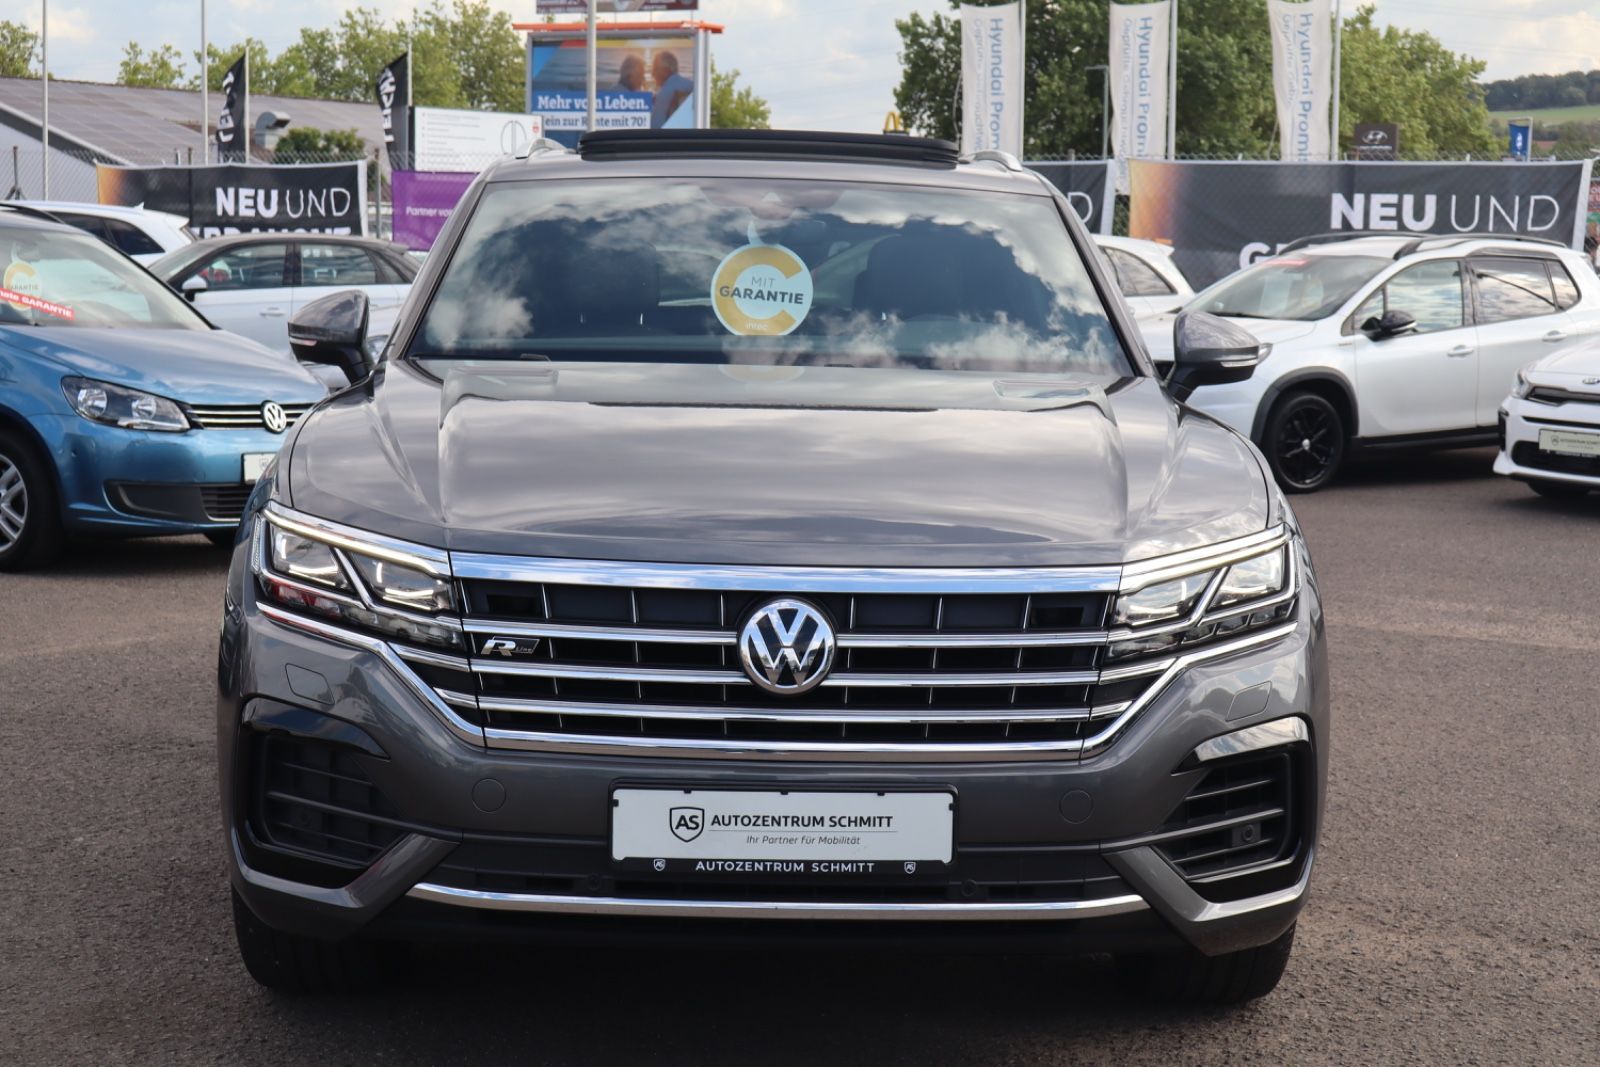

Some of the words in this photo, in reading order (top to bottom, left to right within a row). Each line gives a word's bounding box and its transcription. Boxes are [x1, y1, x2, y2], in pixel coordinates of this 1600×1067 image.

[989, 18, 1004, 97] Hyundai
[1136, 17, 1152, 97] Hyundai
[1297, 13, 1313, 95] Hyundai
[537, 94, 572, 110] Mehr
[604, 94, 649, 110] Leben.
[545, 116, 561, 127] ein
[563, 118, 579, 127] zur
[581, 116, 610, 127] Rnte
[612, 116, 628, 127] mit
[216, 186, 278, 218] NEU
[285, 187, 351, 219] UND
[406, 205, 437, 217] Partner
[1330, 192, 1437, 231] NEU
[1450, 193, 1560, 232] UND
[751, 275, 776, 288] MIT
[719, 285, 804, 305] GARANTIE
[21, 295, 73, 318] GARANTIE
[480, 639, 517, 657] R
[744, 603, 830, 691] VW
[674, 814, 700, 830] AS
[710, 814, 825, 828] AUTOZENTRUM
[828, 815, 893, 828] SCHMITT
[746, 835, 759, 845] Ihr
[762, 835, 798, 845] Partner
[801, 835, 815, 845] für
[818, 835, 861, 846] Mobilität
[695, 861, 805, 873] AUTOZENTRUM
[811, 862, 875, 874] SCHMITT
